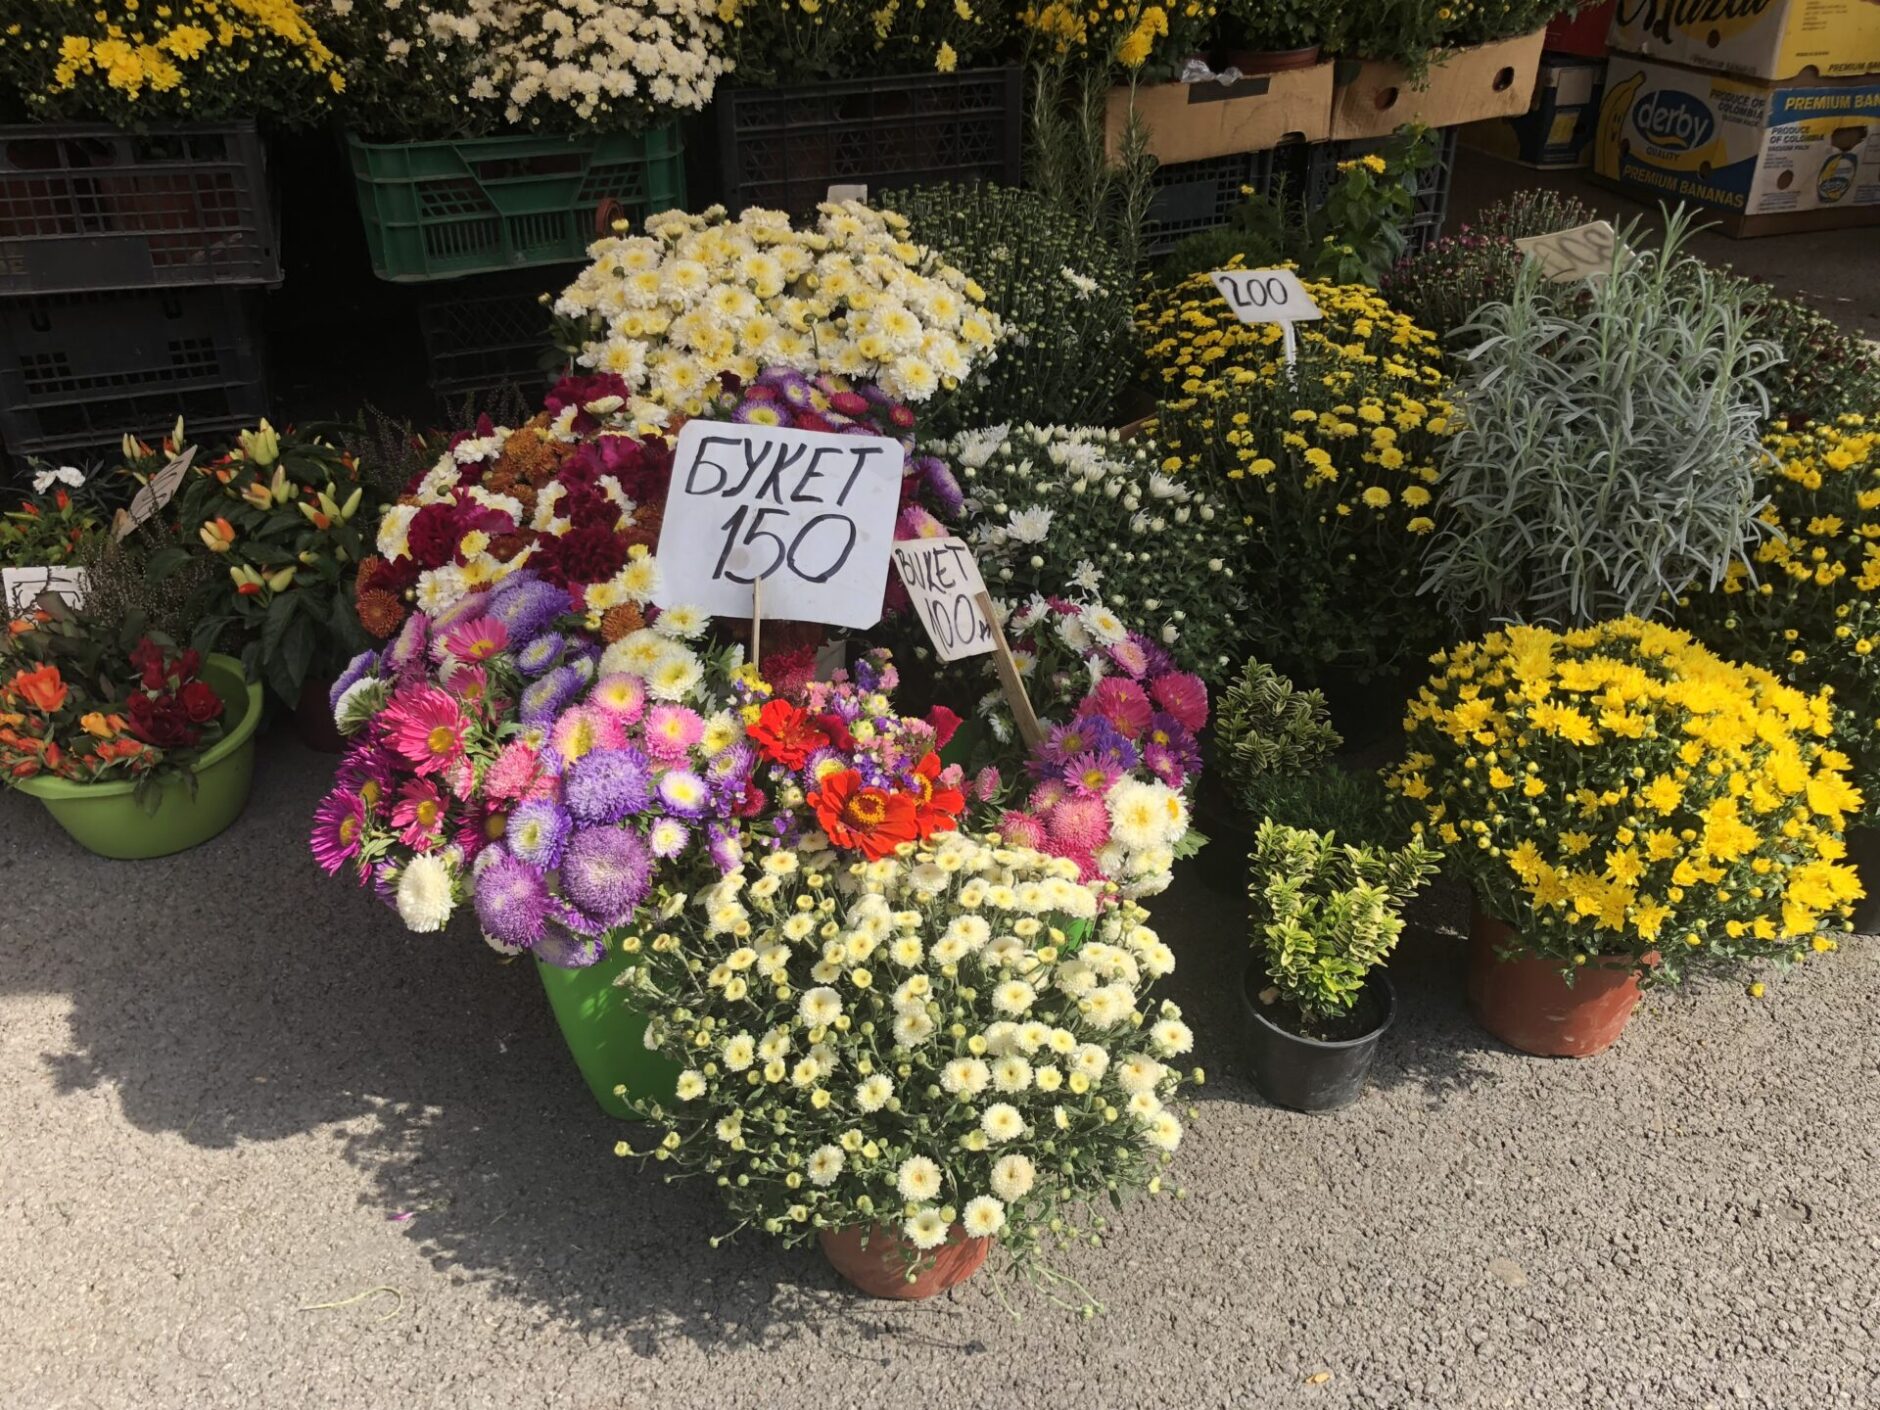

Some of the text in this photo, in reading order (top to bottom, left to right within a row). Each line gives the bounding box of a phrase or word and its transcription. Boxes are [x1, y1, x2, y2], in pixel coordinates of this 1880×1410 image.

[1710, 89, 1766, 109] PRODUCE OF
[1717, 102, 1764, 119] COLOMBIA
[1785, 95, 1851, 111] PREMIUM
[1637, 91, 1712, 150] derby
[1646, 145, 1680, 161] QUALITY
[1769, 135, 1782, 143] OF
[1623, 164, 1678, 192] PREMIUM
[1679, 179, 1745, 207] BANANAS
[1219, 275, 1289, 307] 200
[684, 436, 884, 507] БУКЕТ
[711, 504, 857, 584] 150
[924, 594, 975, 655] 100
